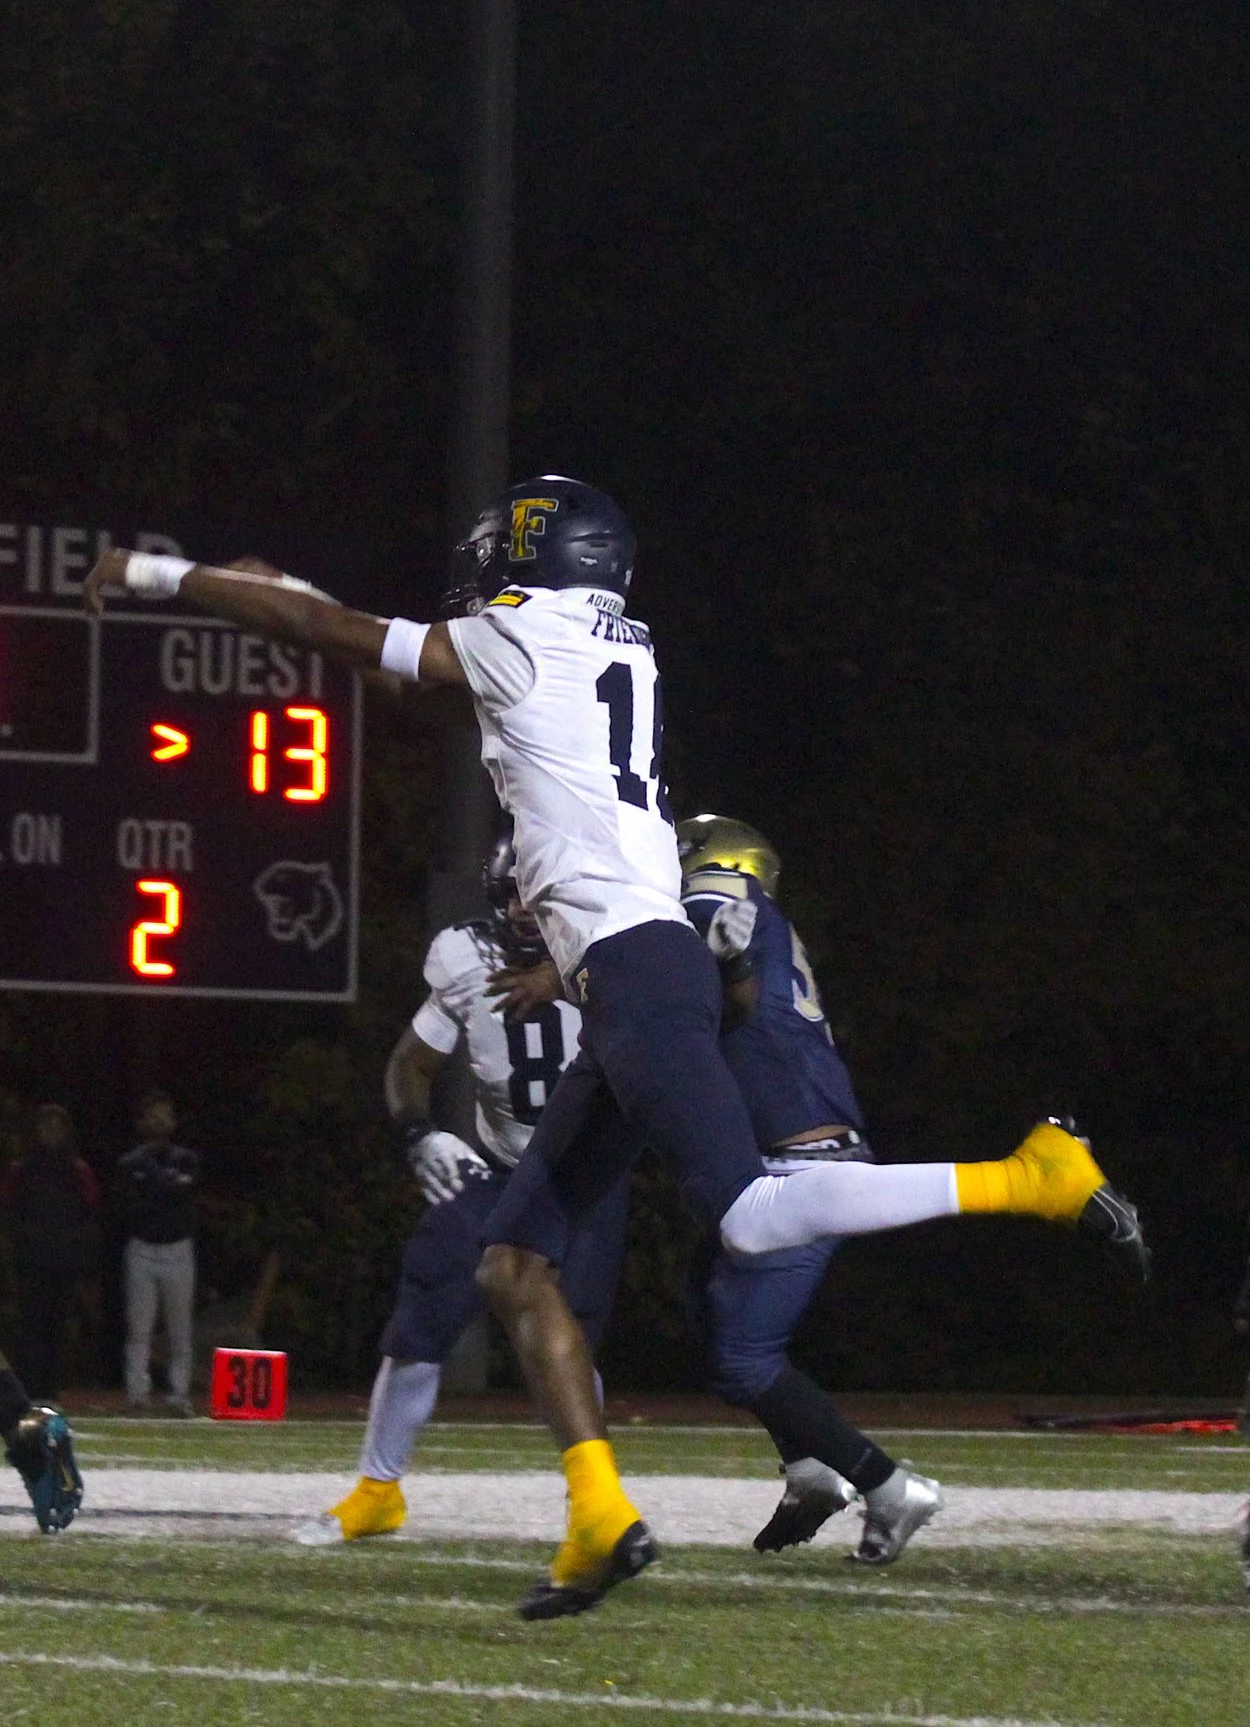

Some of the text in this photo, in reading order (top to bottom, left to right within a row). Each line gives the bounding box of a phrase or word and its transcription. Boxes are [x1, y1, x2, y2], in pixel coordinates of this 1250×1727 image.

[508, 497, 559, 562] F
[250, 706, 329, 802] 13
[11, 811, 61, 864] ON
[116, 817, 193, 871] QTR
[130, 880, 180, 978] 2
[225, 1355, 274, 1410] 30
